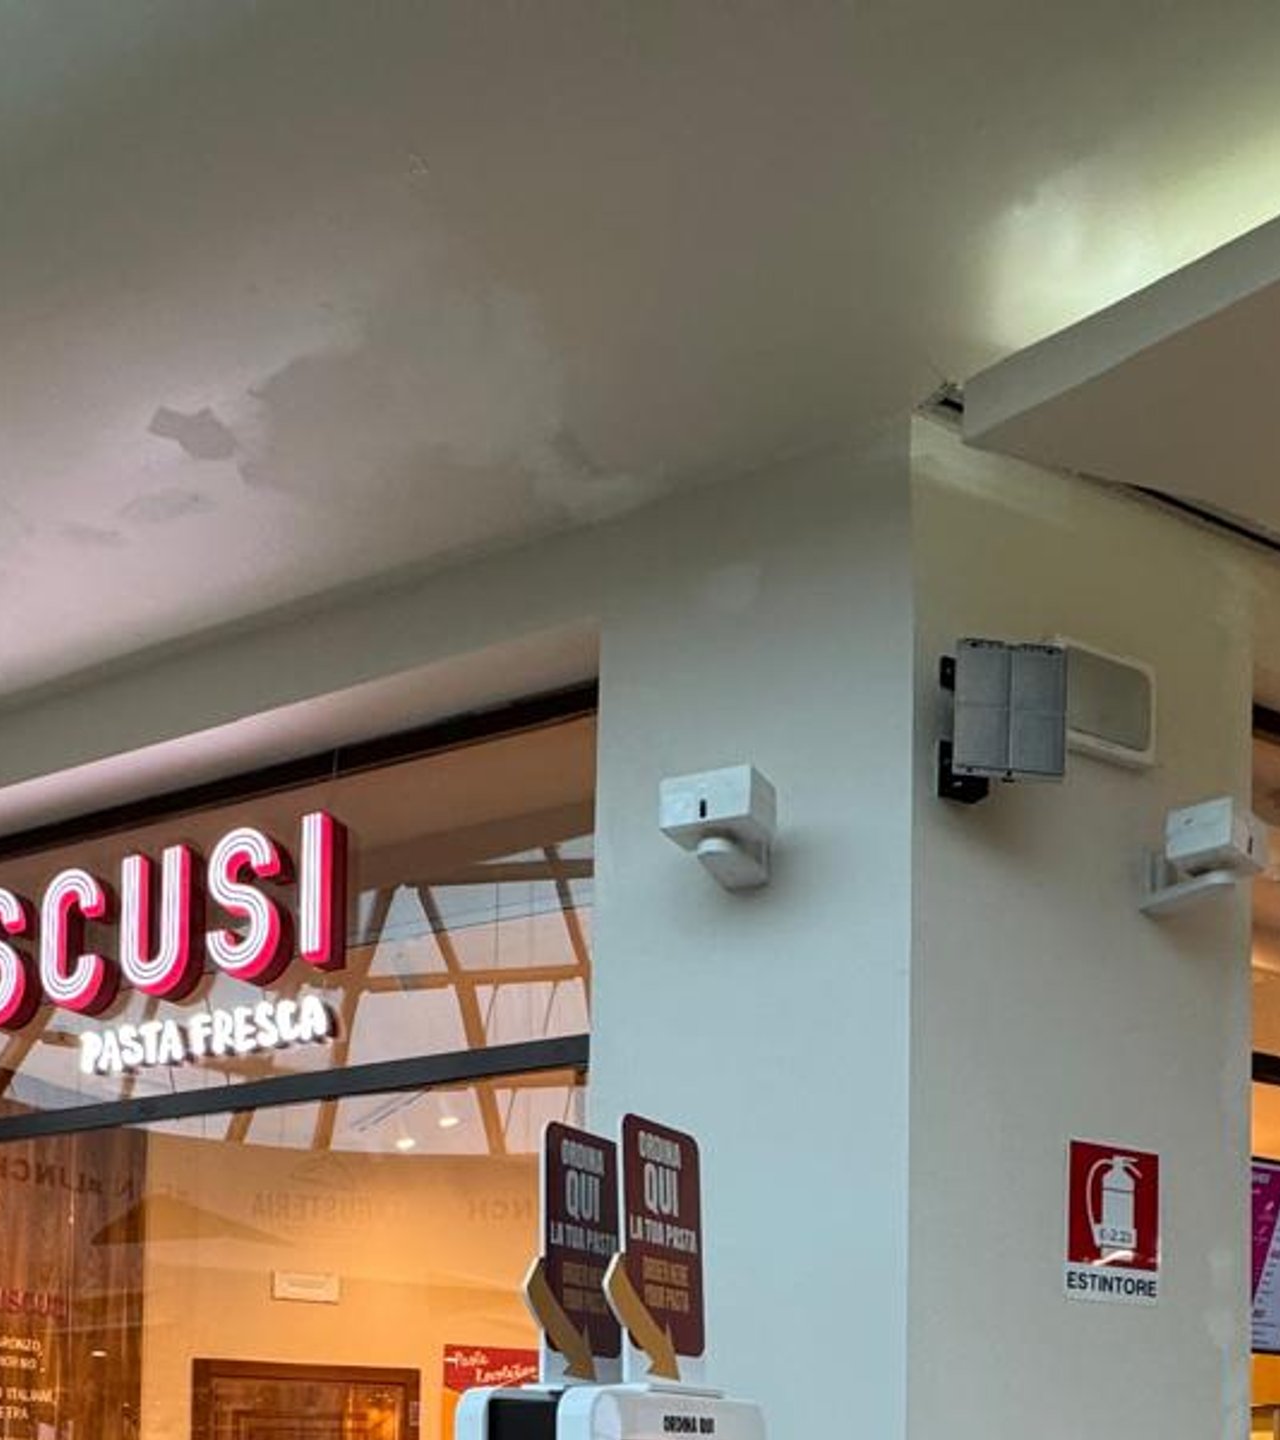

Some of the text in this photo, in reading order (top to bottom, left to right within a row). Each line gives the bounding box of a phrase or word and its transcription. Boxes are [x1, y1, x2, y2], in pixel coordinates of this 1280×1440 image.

[79, 995, 329, 1074] PASTA FRESCA
[565, 1169, 601, 1222] QUI
[643, 1163, 680, 1217] QUI
[630, 1214, 643, 1240] LA
[1066, 1271, 1158, 1298] ESTINTORE
